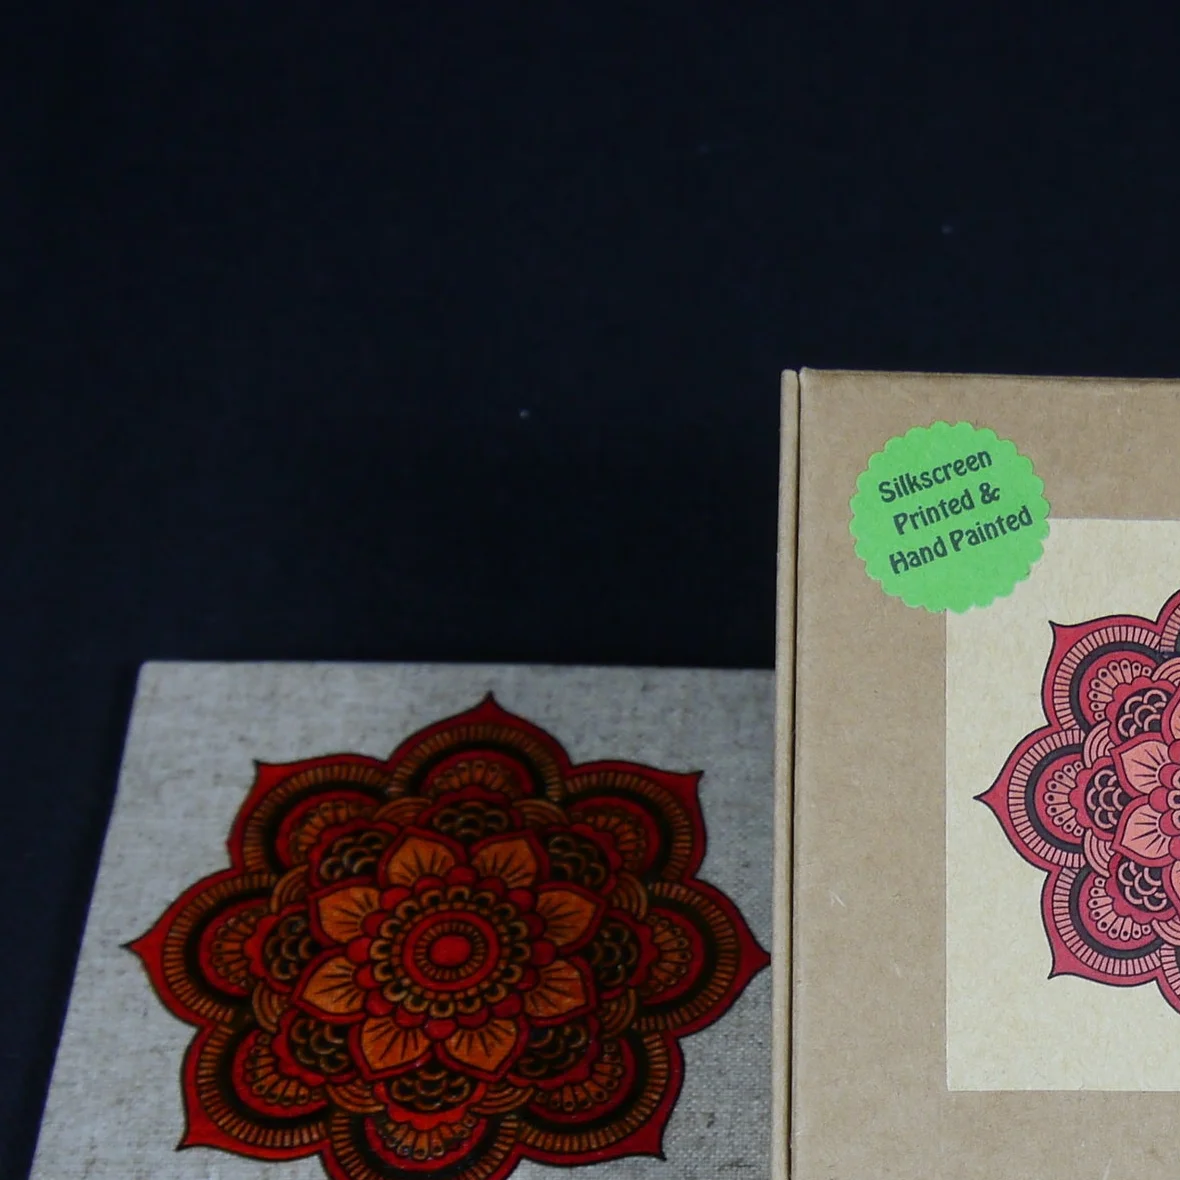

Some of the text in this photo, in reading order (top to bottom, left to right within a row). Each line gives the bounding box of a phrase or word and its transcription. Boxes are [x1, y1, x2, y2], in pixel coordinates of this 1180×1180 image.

[878, 450, 993, 503] Silkscreen
[893, 482, 1001, 536] Printed &
[888, 505, 1033, 575] Hand Painted
